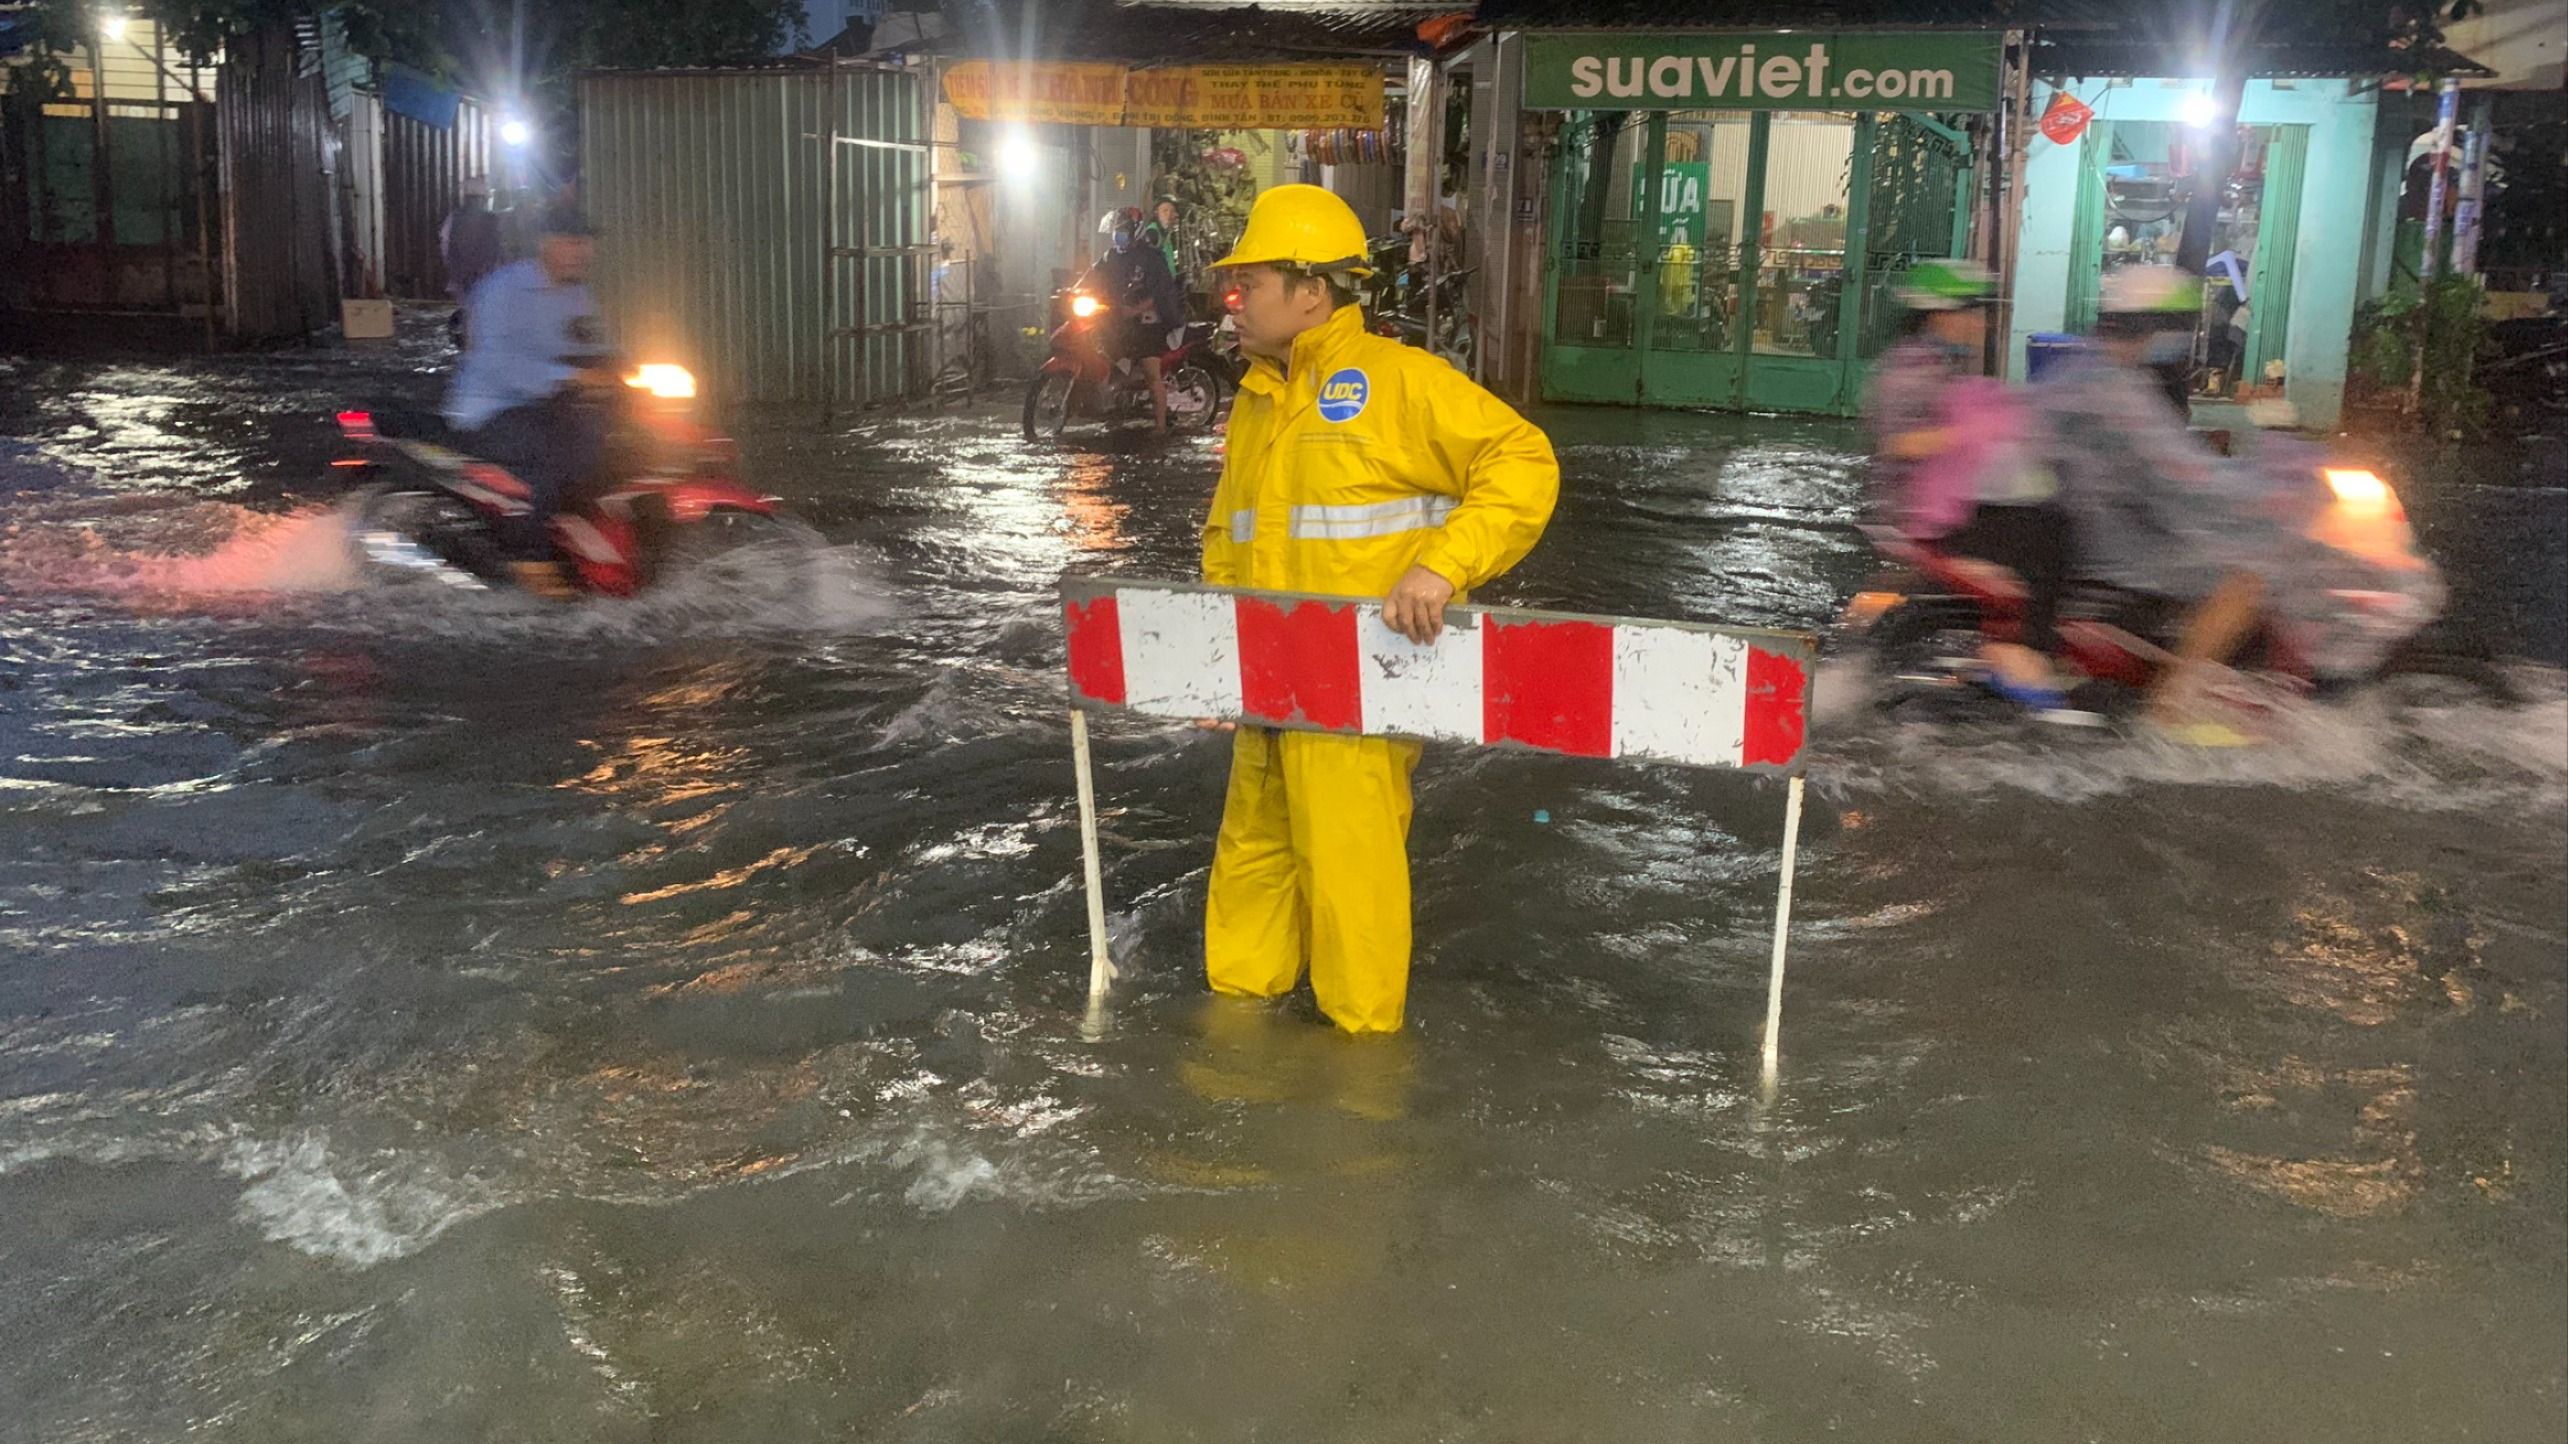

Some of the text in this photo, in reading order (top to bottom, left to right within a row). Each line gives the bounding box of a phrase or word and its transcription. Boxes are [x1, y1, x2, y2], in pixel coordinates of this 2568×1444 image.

[1571, 44, 1954, 98] suaviet.com
[1211, 80, 1248, 89] THAY
[1258, 89, 1297, 110] BÁN
[1304, 94, 1332, 110] XE
[1324, 383, 1363, 401] UDC
